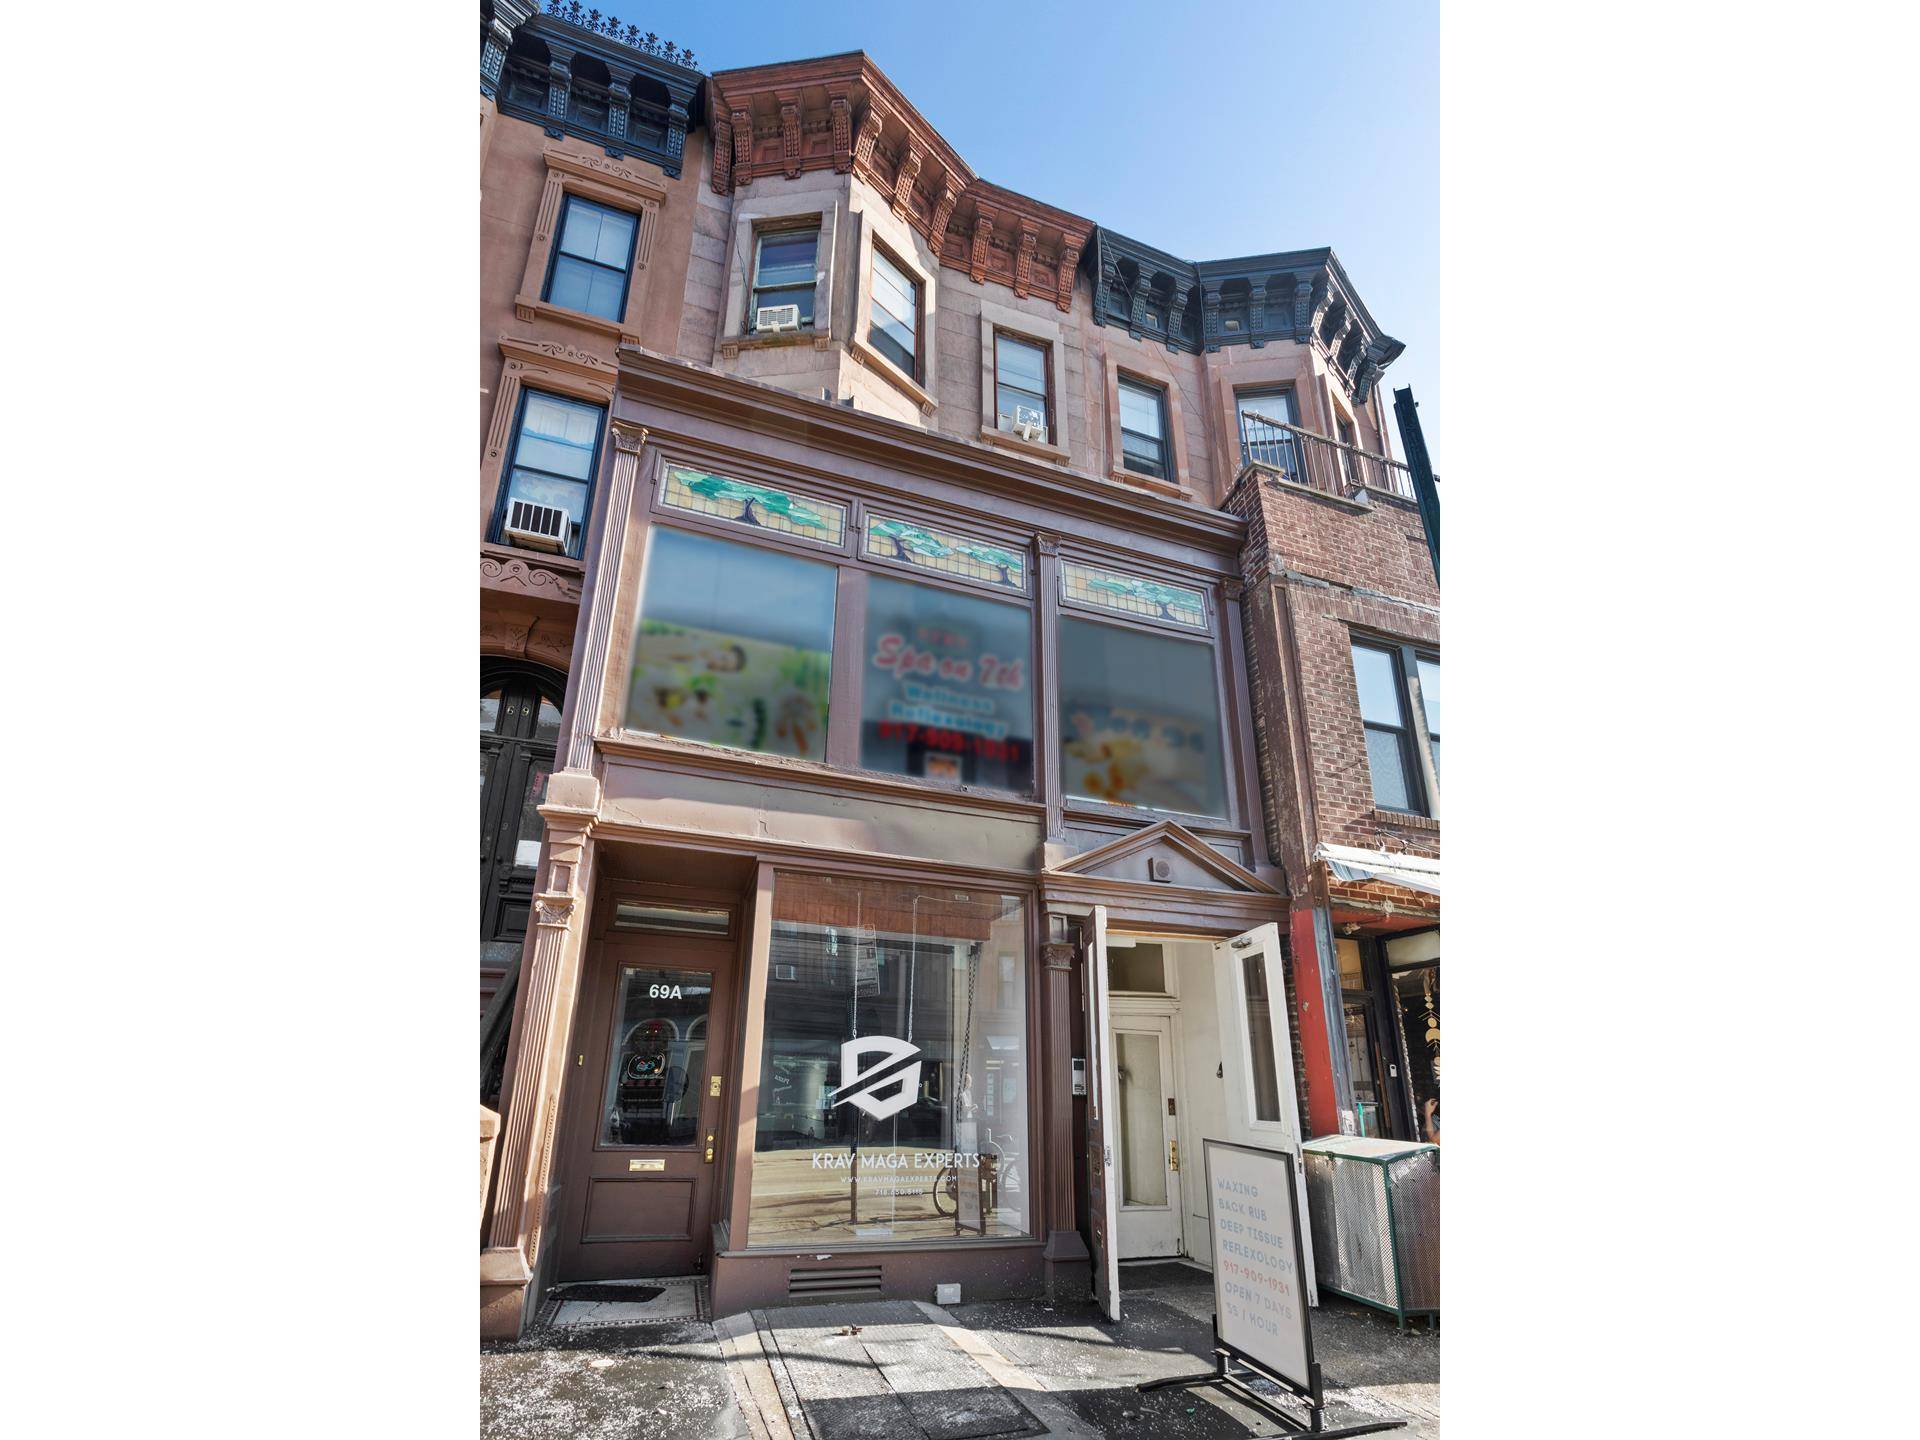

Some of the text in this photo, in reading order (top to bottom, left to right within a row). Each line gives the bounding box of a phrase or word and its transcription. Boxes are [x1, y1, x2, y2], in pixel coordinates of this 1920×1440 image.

[649, 984, 682, 1000] 69A
[812, 1152, 980, 1169] KRAV MAGA EXPERTS
[1217, 1179, 1258, 1198] WAXING
[1217, 1198, 1268, 1222] BACK RUB
[1219, 1219, 1283, 1249] DEEP TISSUE
[1222, 1240, 1293, 1275] REFLEXOLOGY
[1223, 1260, 1291, 1297] 917-909-1931
[1224, 1281, 1293, 1320] OPEN 7 DAYS
[1248, 1312, 1279, 1336] HOUR
